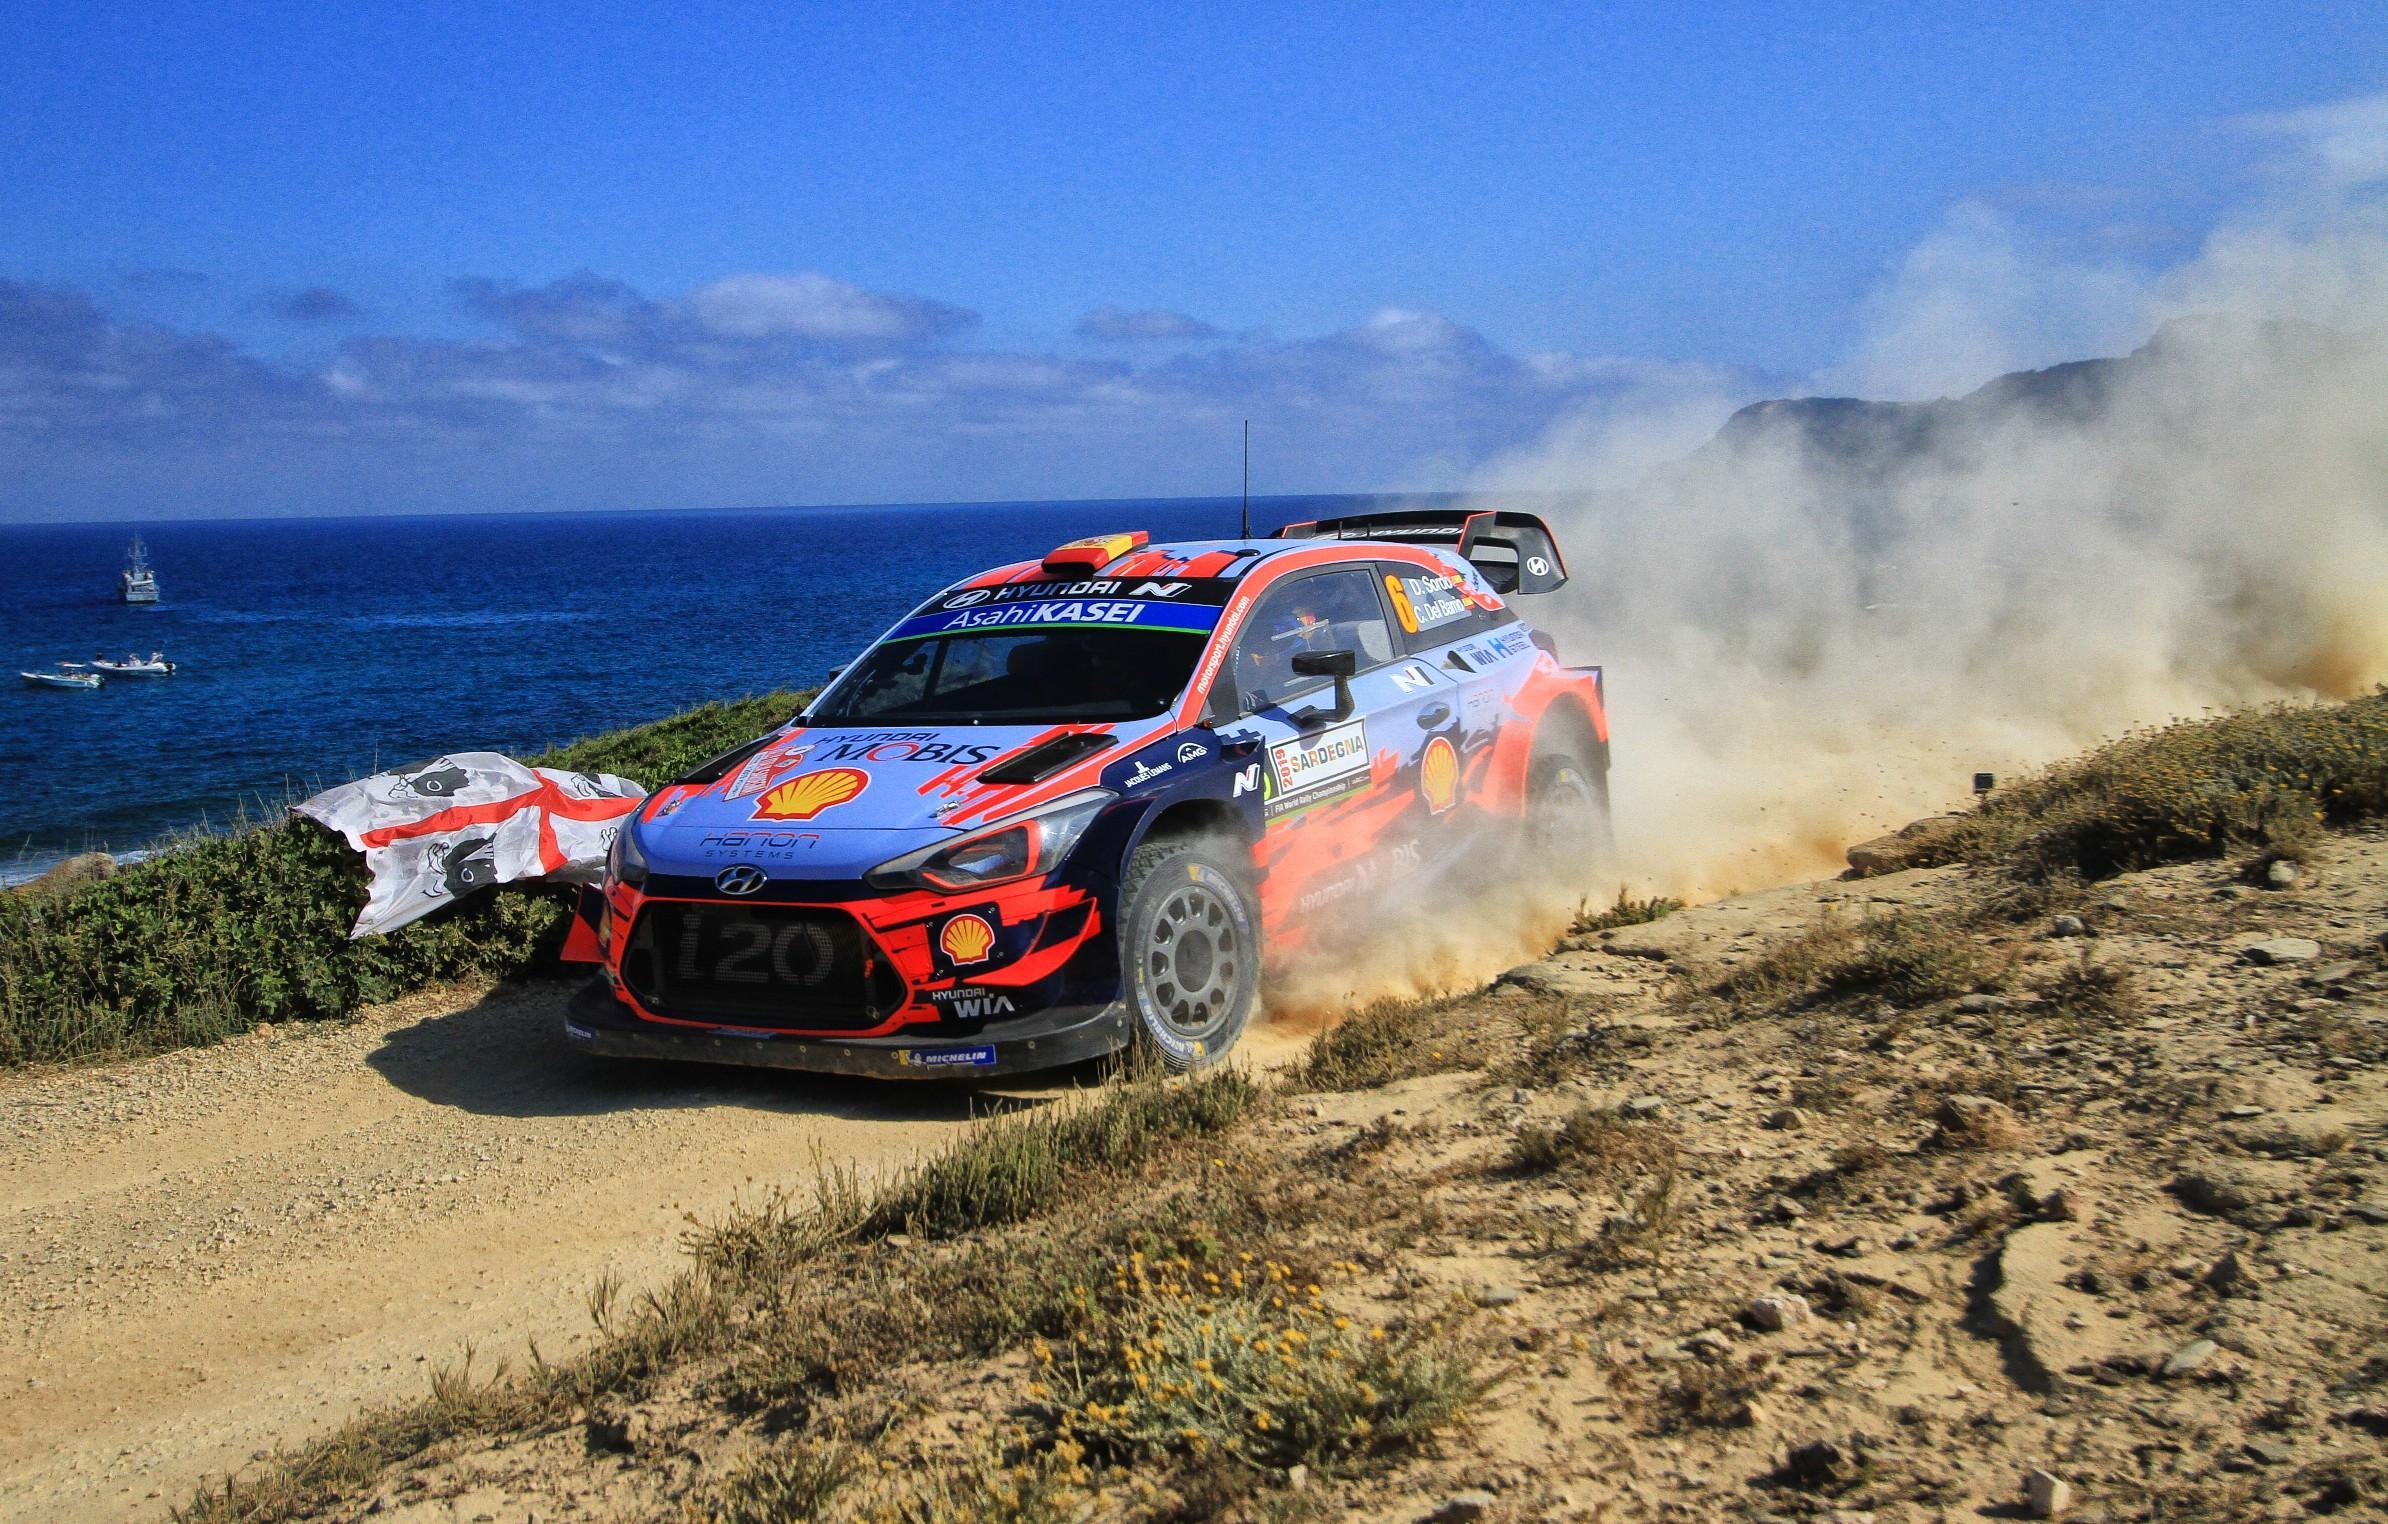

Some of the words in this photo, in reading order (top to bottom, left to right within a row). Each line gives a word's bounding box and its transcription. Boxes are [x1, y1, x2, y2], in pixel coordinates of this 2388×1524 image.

[994, 581, 1121, 600] HYUNDAI
[1408, 579, 1425, 595] D.
[1385, 575, 1418, 633] 6
[1414, 606, 1427, 623] C.
[1424, 602, 1440, 620] Del
[1197, 596, 1249, 694] motorsport.hyundai.com
[816, 733, 941, 745] HYUNDAI
[814, 742, 1001, 764] MOBIS
[1290, 735, 1364, 773] SARDEGNA
[1275, 748, 1293, 788] 2019
[1124, 771, 1151, 788] JACQUES
[705, 850, 793, 860] SYSTEMS
[679, 911, 833, 986] i20
[932, 987, 986, 1000] HYUNDAI
[926, 1052, 987, 1063] MICHELIN
